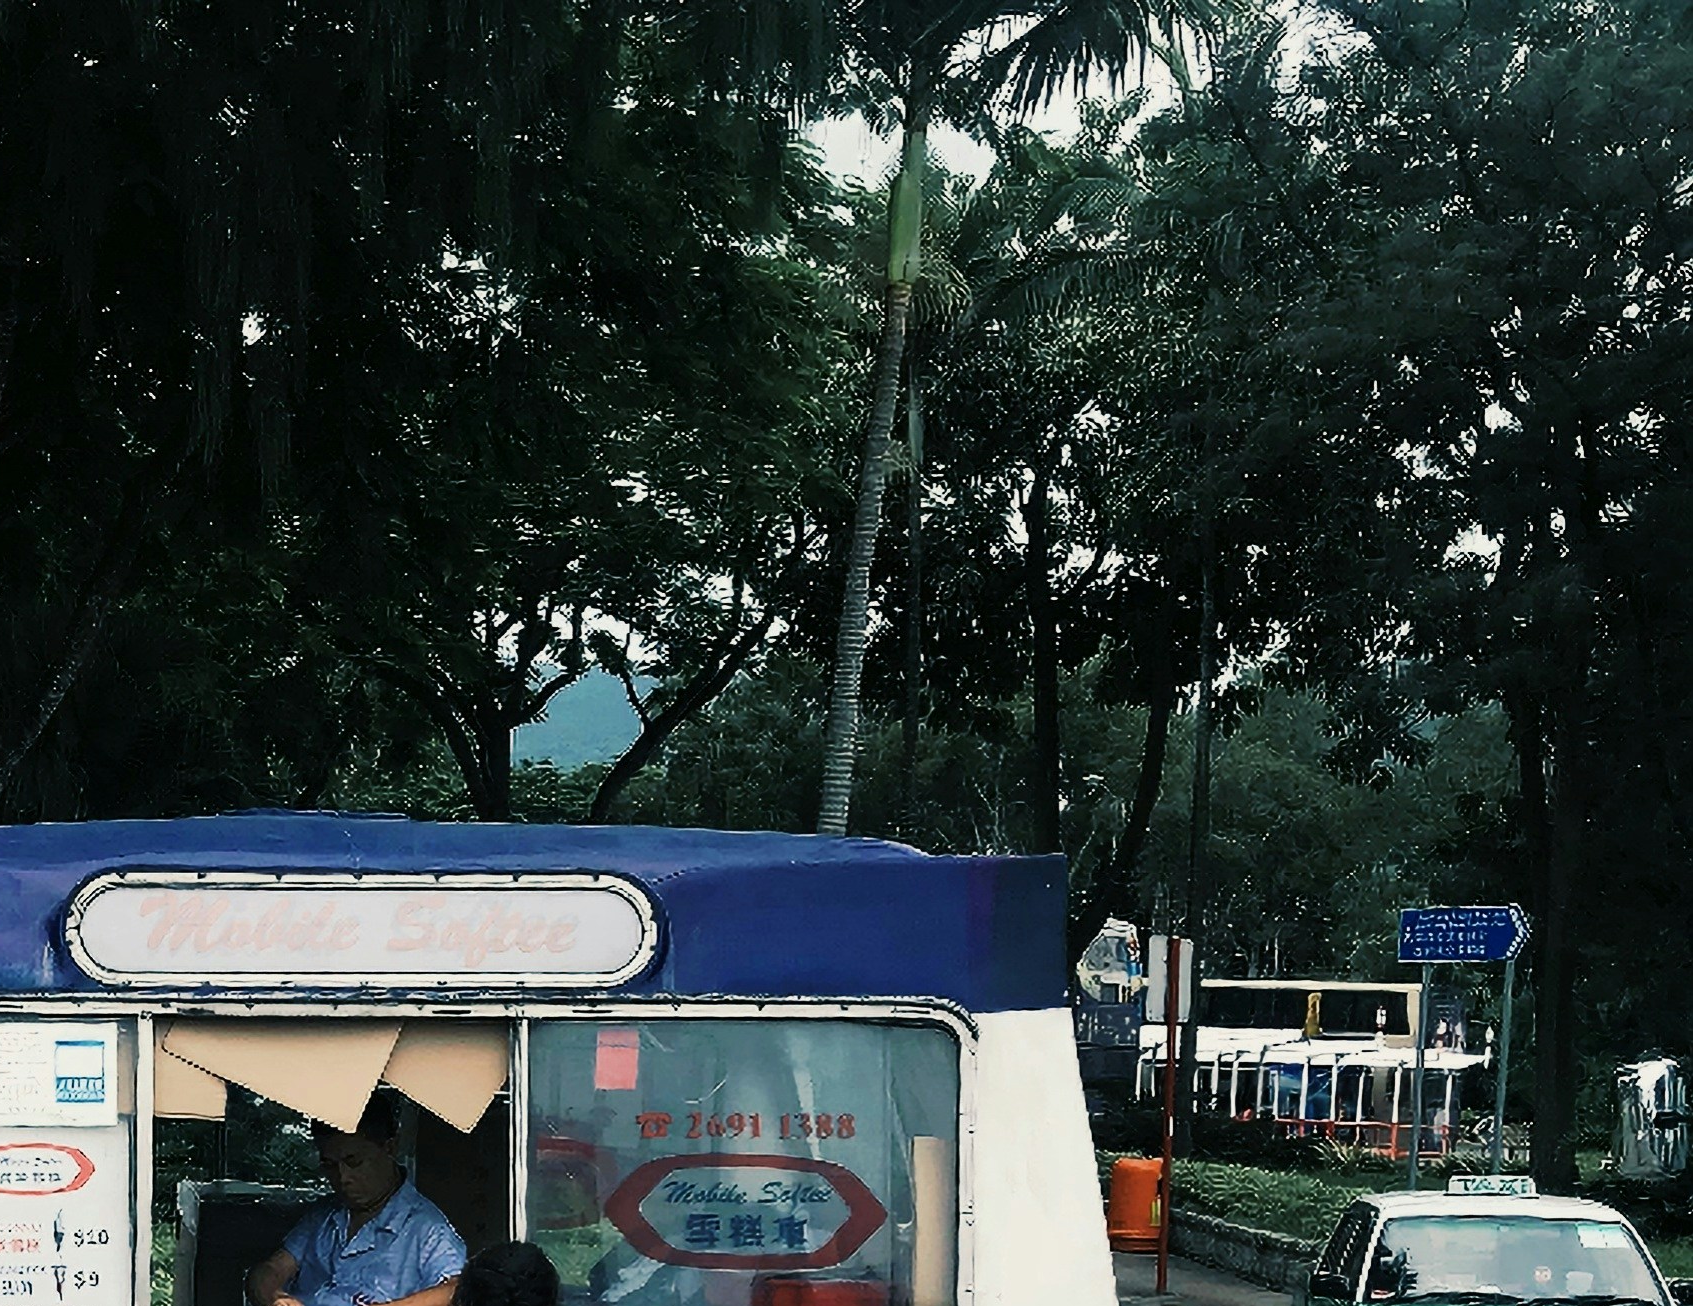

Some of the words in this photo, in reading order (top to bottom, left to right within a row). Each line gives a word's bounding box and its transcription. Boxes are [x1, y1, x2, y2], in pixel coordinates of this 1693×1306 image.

[685, 1112, 763, 1140] 2691
[780, 1112, 857, 1140] 1388
[1452, 1178, 1532, 1195] TAXI
[74, 1229, 110, 1248] $10
[685, 1213, 809, 1249] 雪糕車
[73, 1271, 100, 1290] $9
